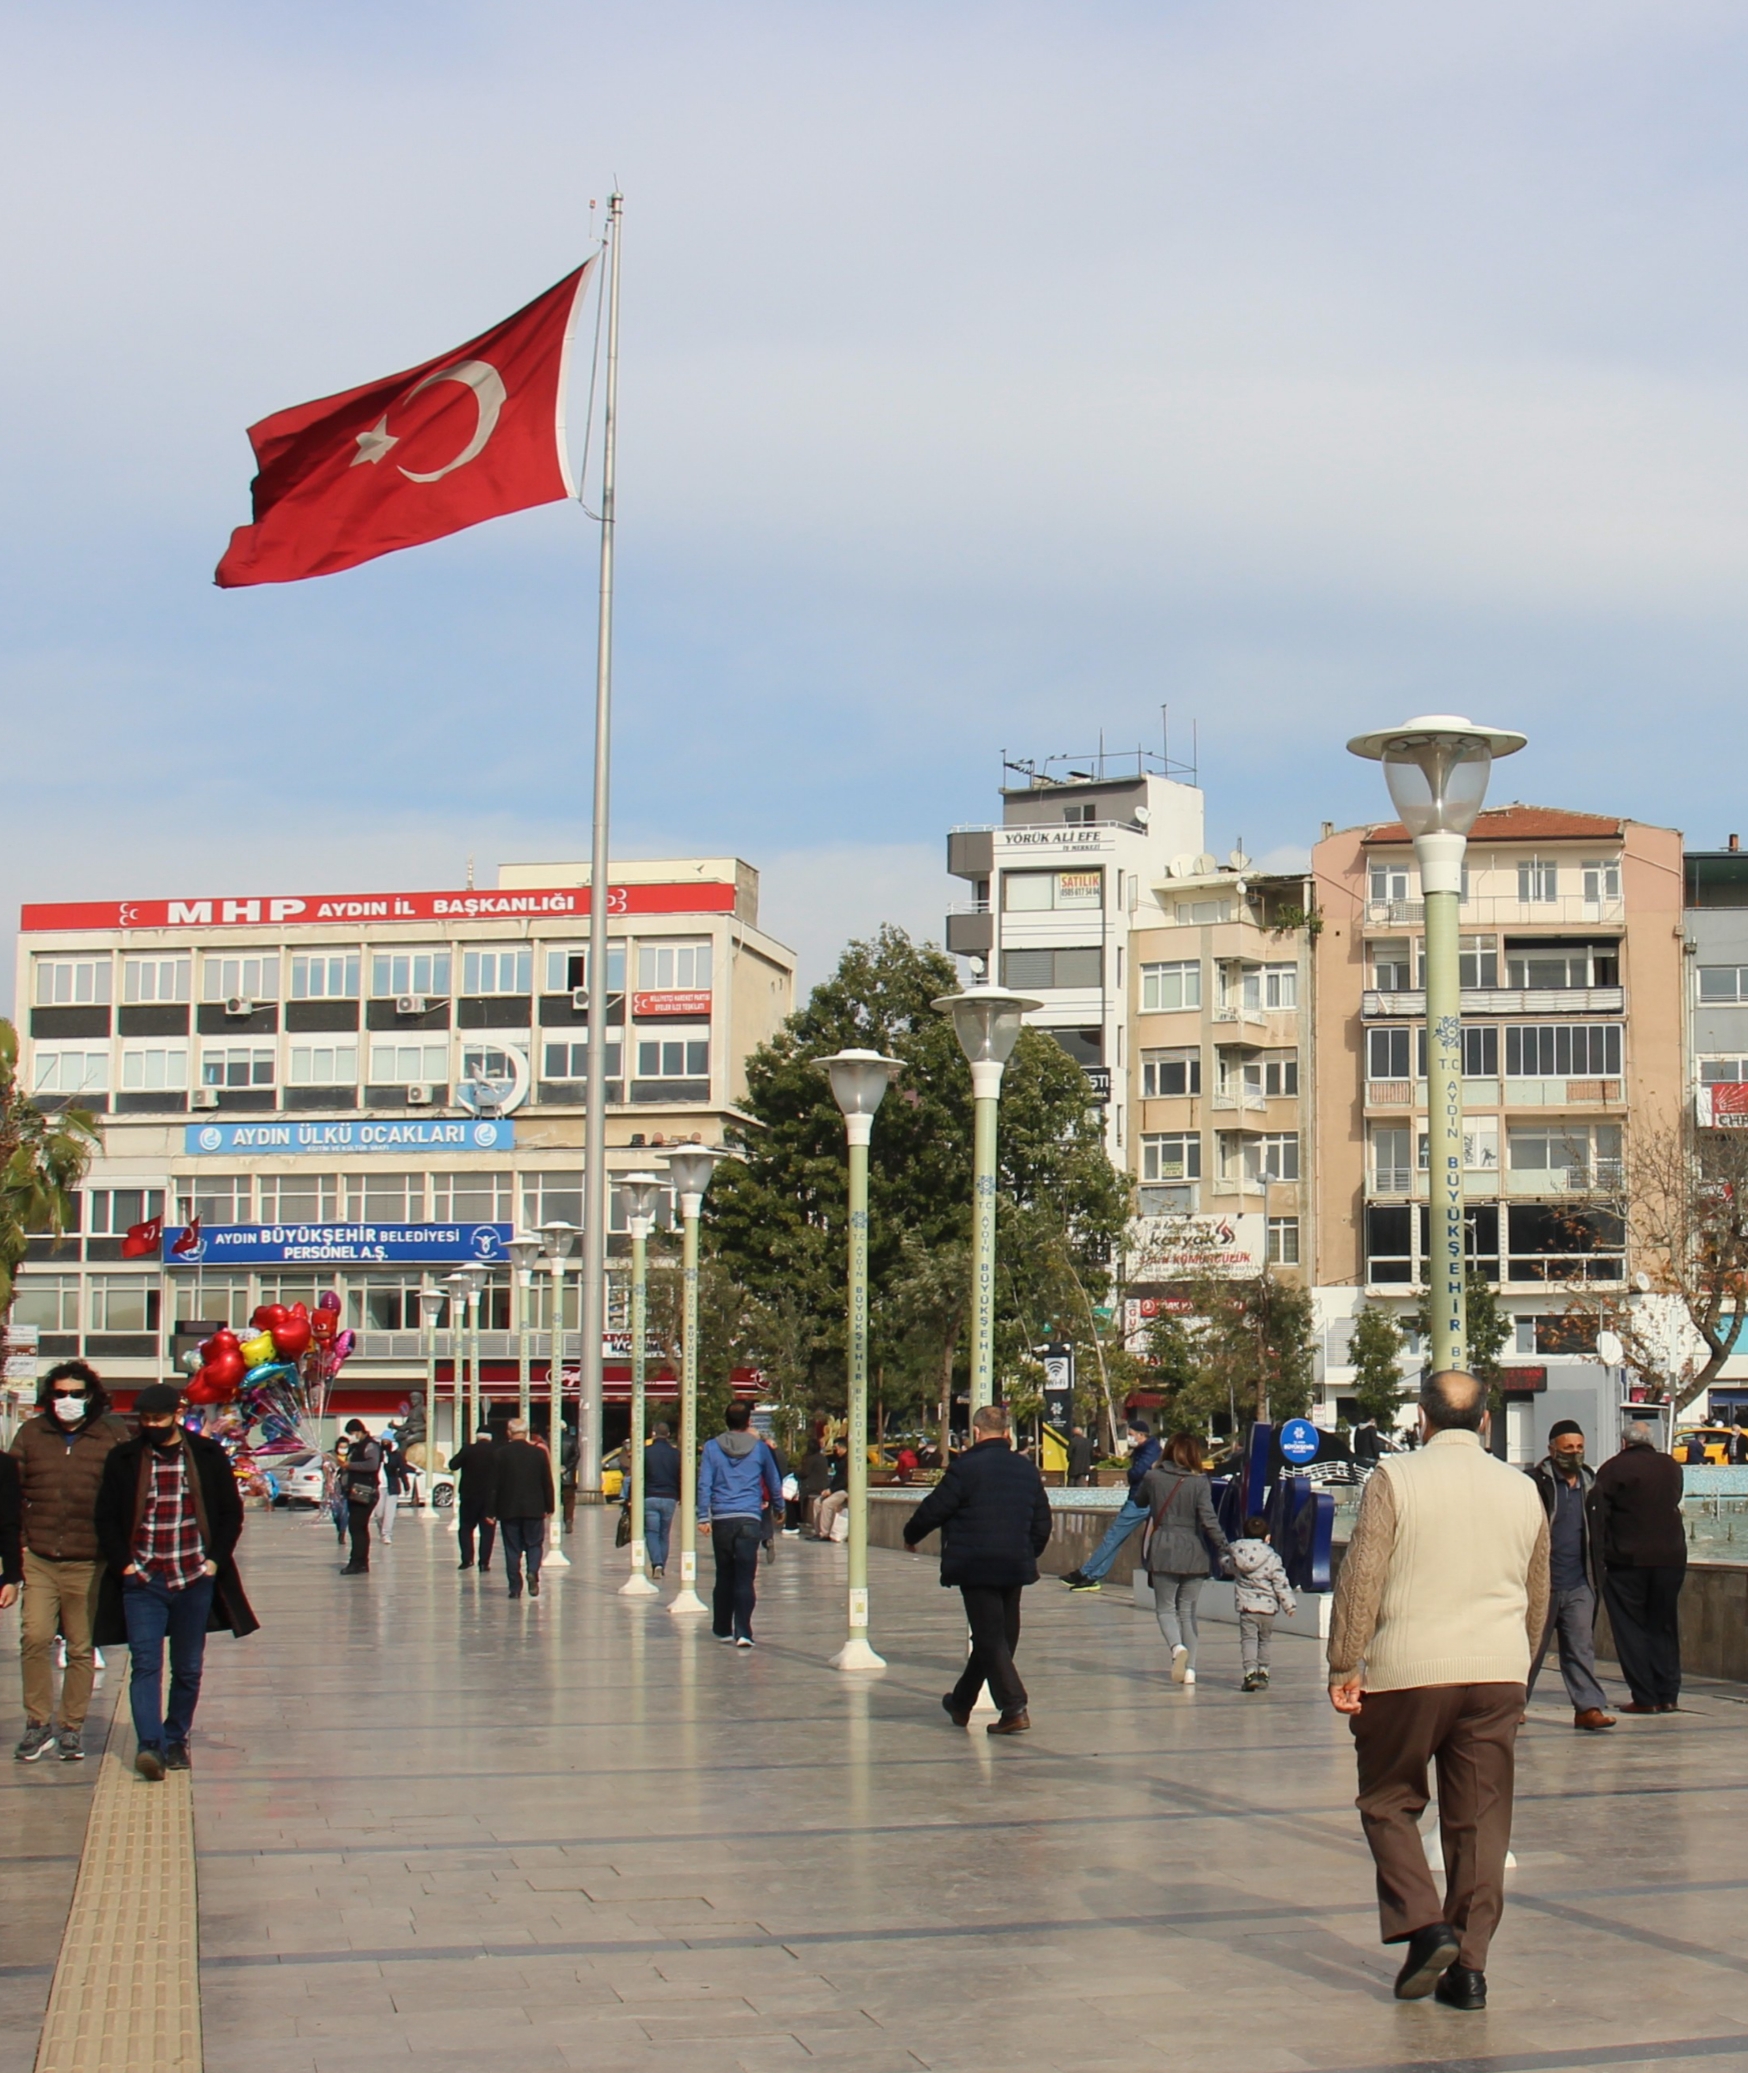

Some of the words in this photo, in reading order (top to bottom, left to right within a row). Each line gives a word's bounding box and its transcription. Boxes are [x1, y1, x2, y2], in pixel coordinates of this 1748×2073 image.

[1005, 831, 1050, 844] YÖRÜK
[1053, 830, 1075, 843] ALİ
[1078, 831, 1101, 841] EFE
[1061, 875, 1100, 887] SATILIK
[167, 899, 307, 924] MHP
[316, 901, 388, 917] AYDIN
[394, 897, 416, 915] İL
[432, 892, 575, 917] BAŞKANLIĞI
[1446, 1080, 1459, 1139] AYDIN
[232, 1127, 291, 1146] AYDIN
[298, 1122, 352, 1145] ÜLKÜ
[360, 1124, 466, 1144] OCAKLARI
[215, 1233, 257, 1245] AYDIN
[260, 1226, 377, 1246] BÜYÜKŞEHİR
[380, 1228, 460, 1242] BELEDİYESİ
[1447, 1156, 1461, 1332] BÜYÜKŞEHİR
[284, 1246, 358, 1259] PERSONEL
[360, 1246, 389, 1262] A.Ş.
